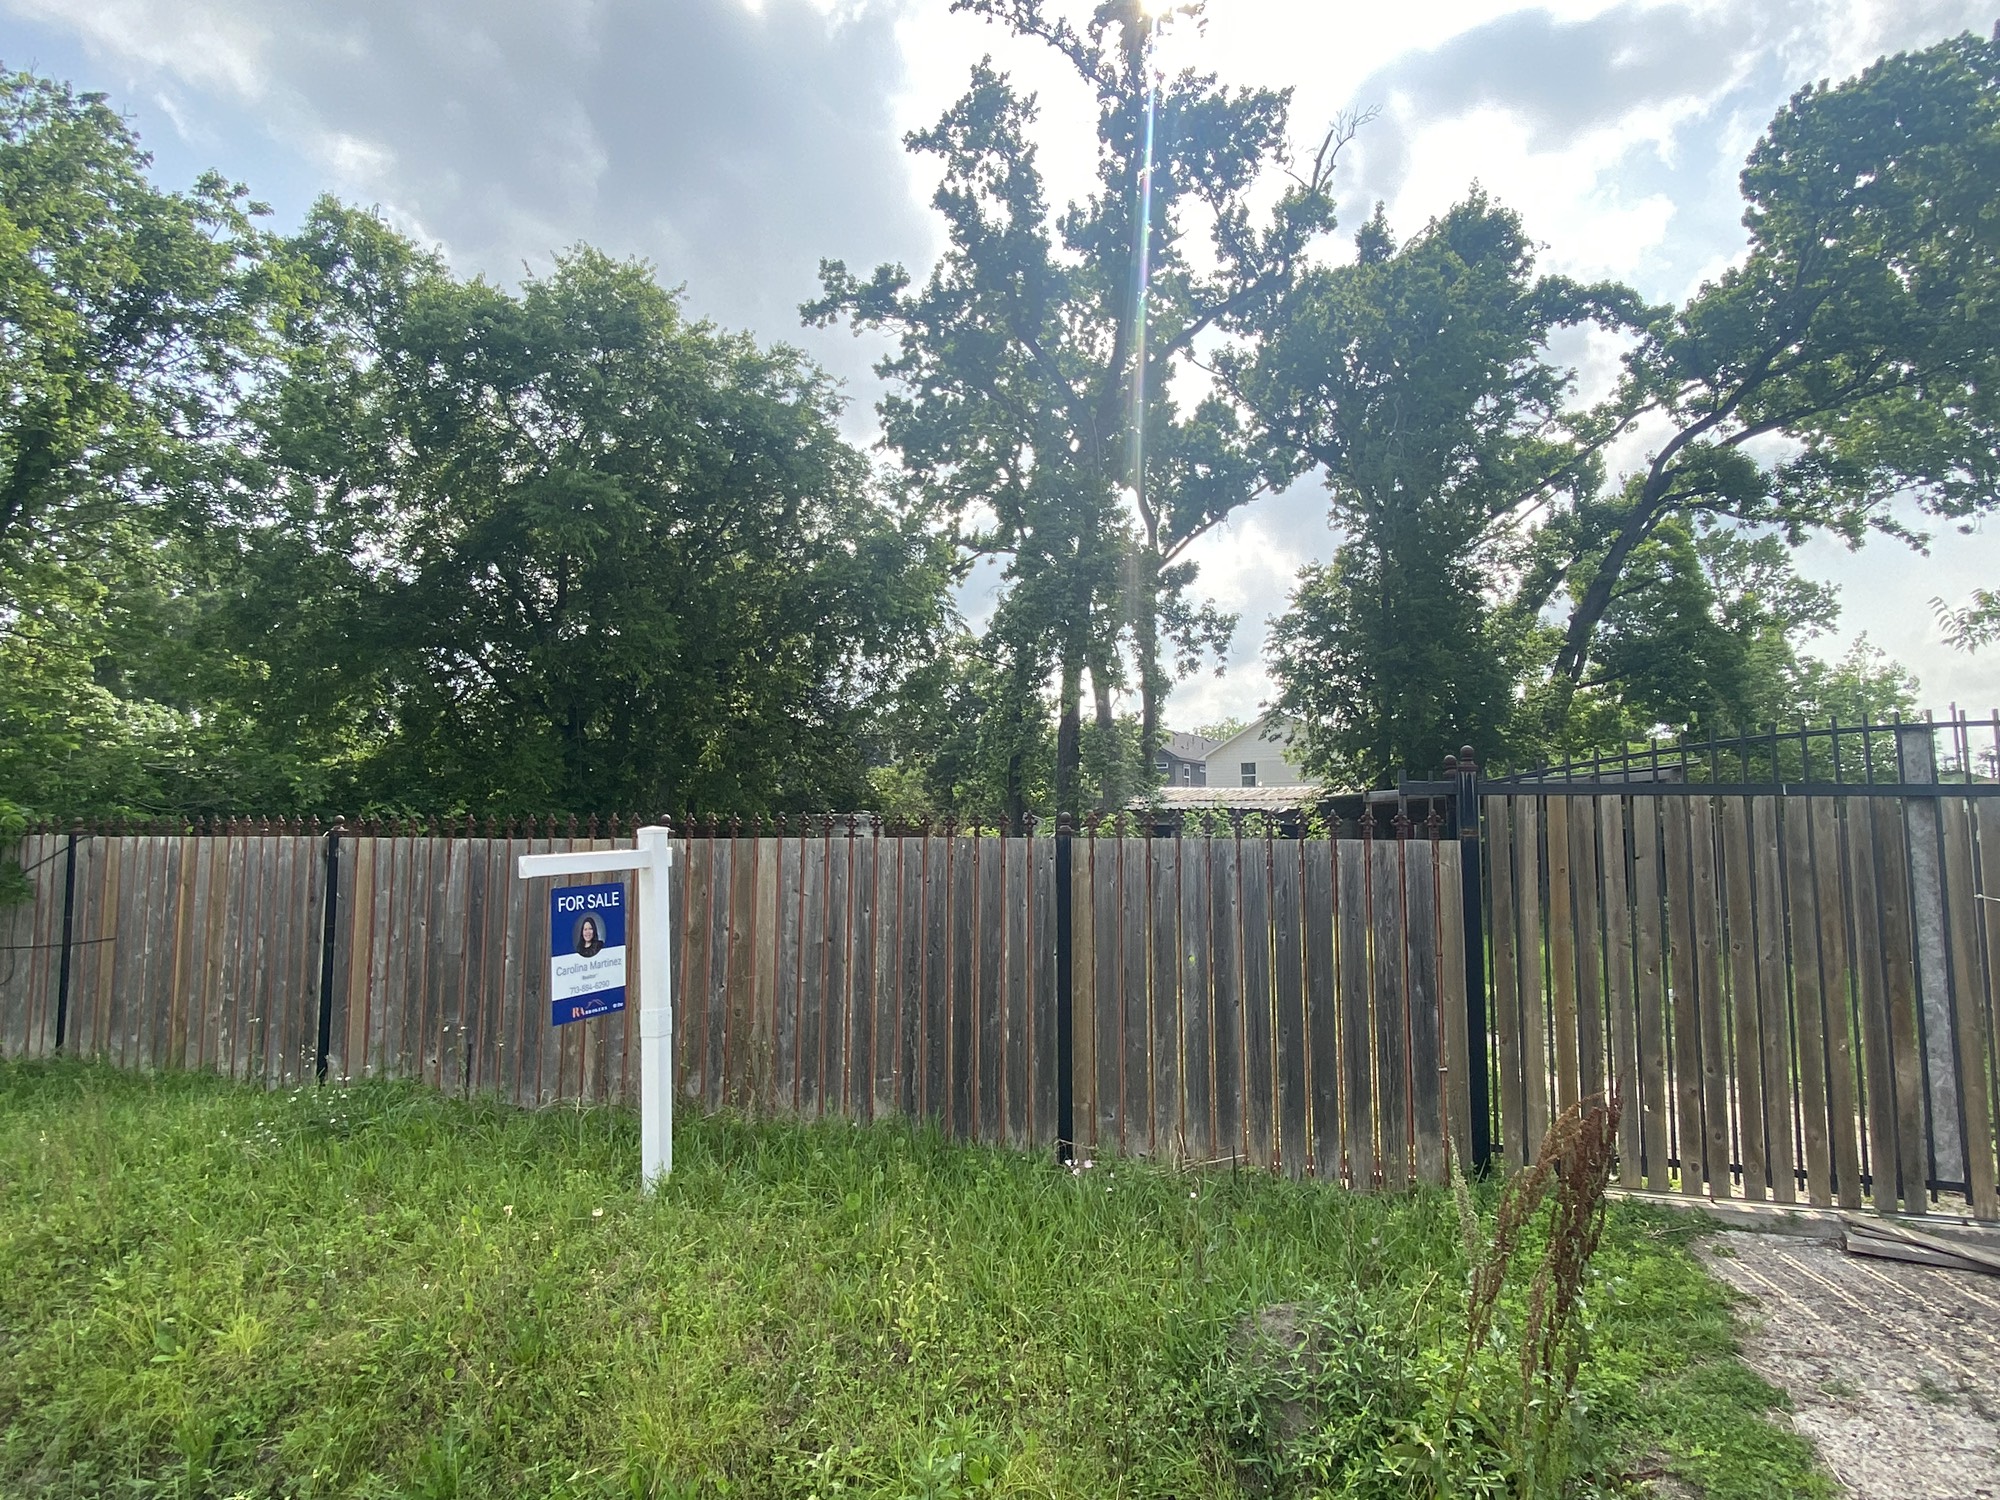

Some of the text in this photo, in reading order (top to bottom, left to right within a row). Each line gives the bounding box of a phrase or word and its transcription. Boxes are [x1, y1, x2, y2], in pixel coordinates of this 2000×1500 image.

[558, 891, 619, 912] FOR SALE
[556, 958, 621, 976] Carolina Martinez
